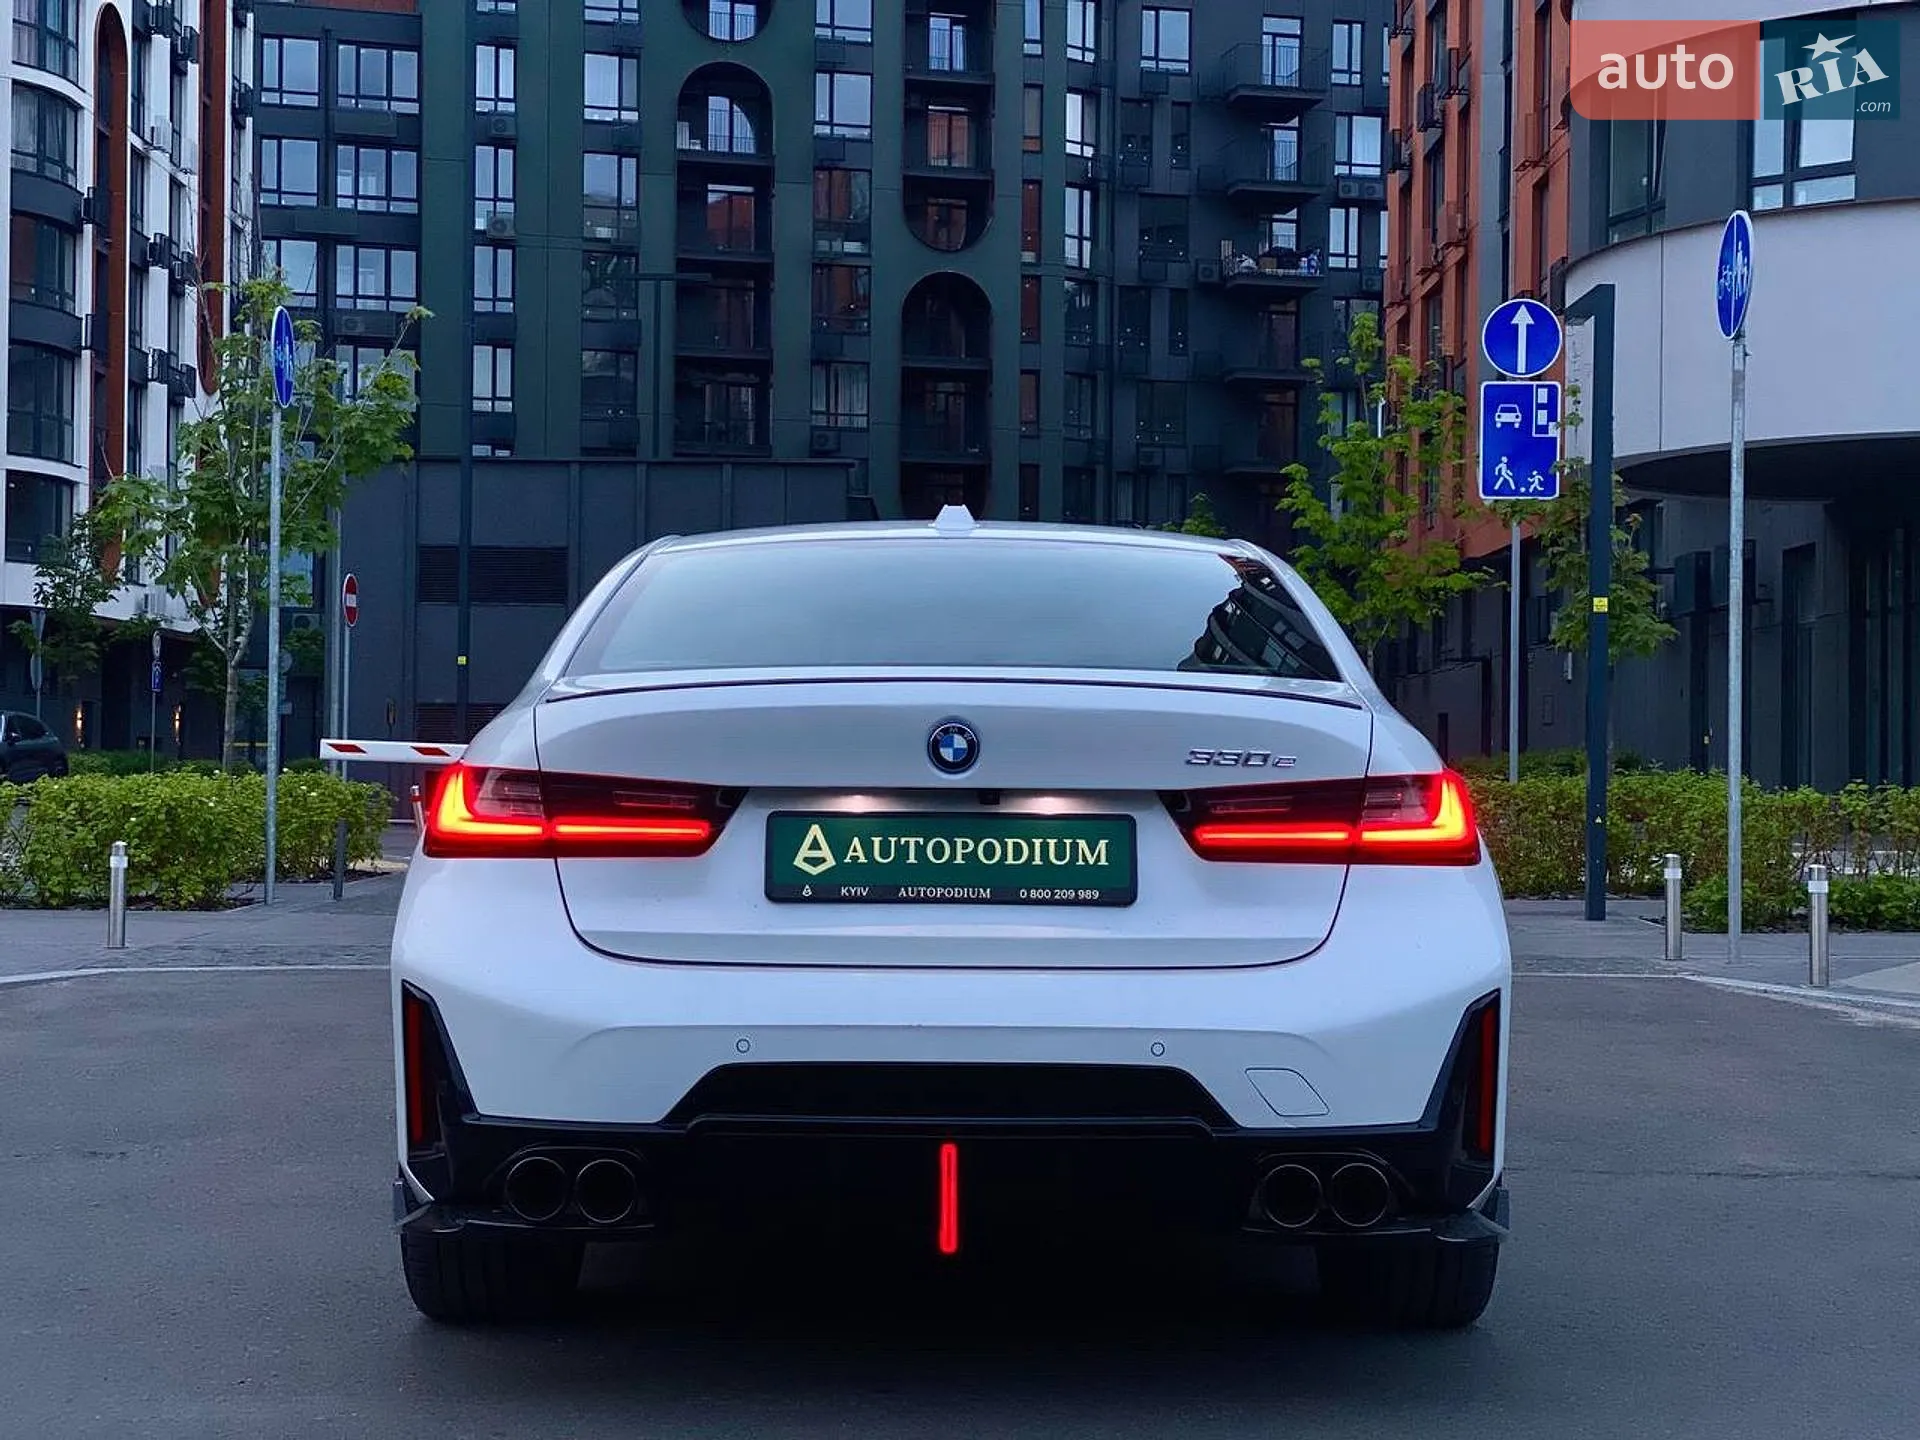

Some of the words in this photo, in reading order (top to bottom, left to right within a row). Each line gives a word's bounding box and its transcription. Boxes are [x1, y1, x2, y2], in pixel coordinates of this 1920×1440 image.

[843, 836, 1110, 866] AUTOPODIUM
[840, 886, 869, 897] KYIV
[898, 887, 991, 899] AUTOPODIUM
[1019, 889, 1028, 899] 0
[1029, 889, 1051, 899] 800
[1053, 889, 1075, 900] 209
[1077, 889, 1100, 900] 989
